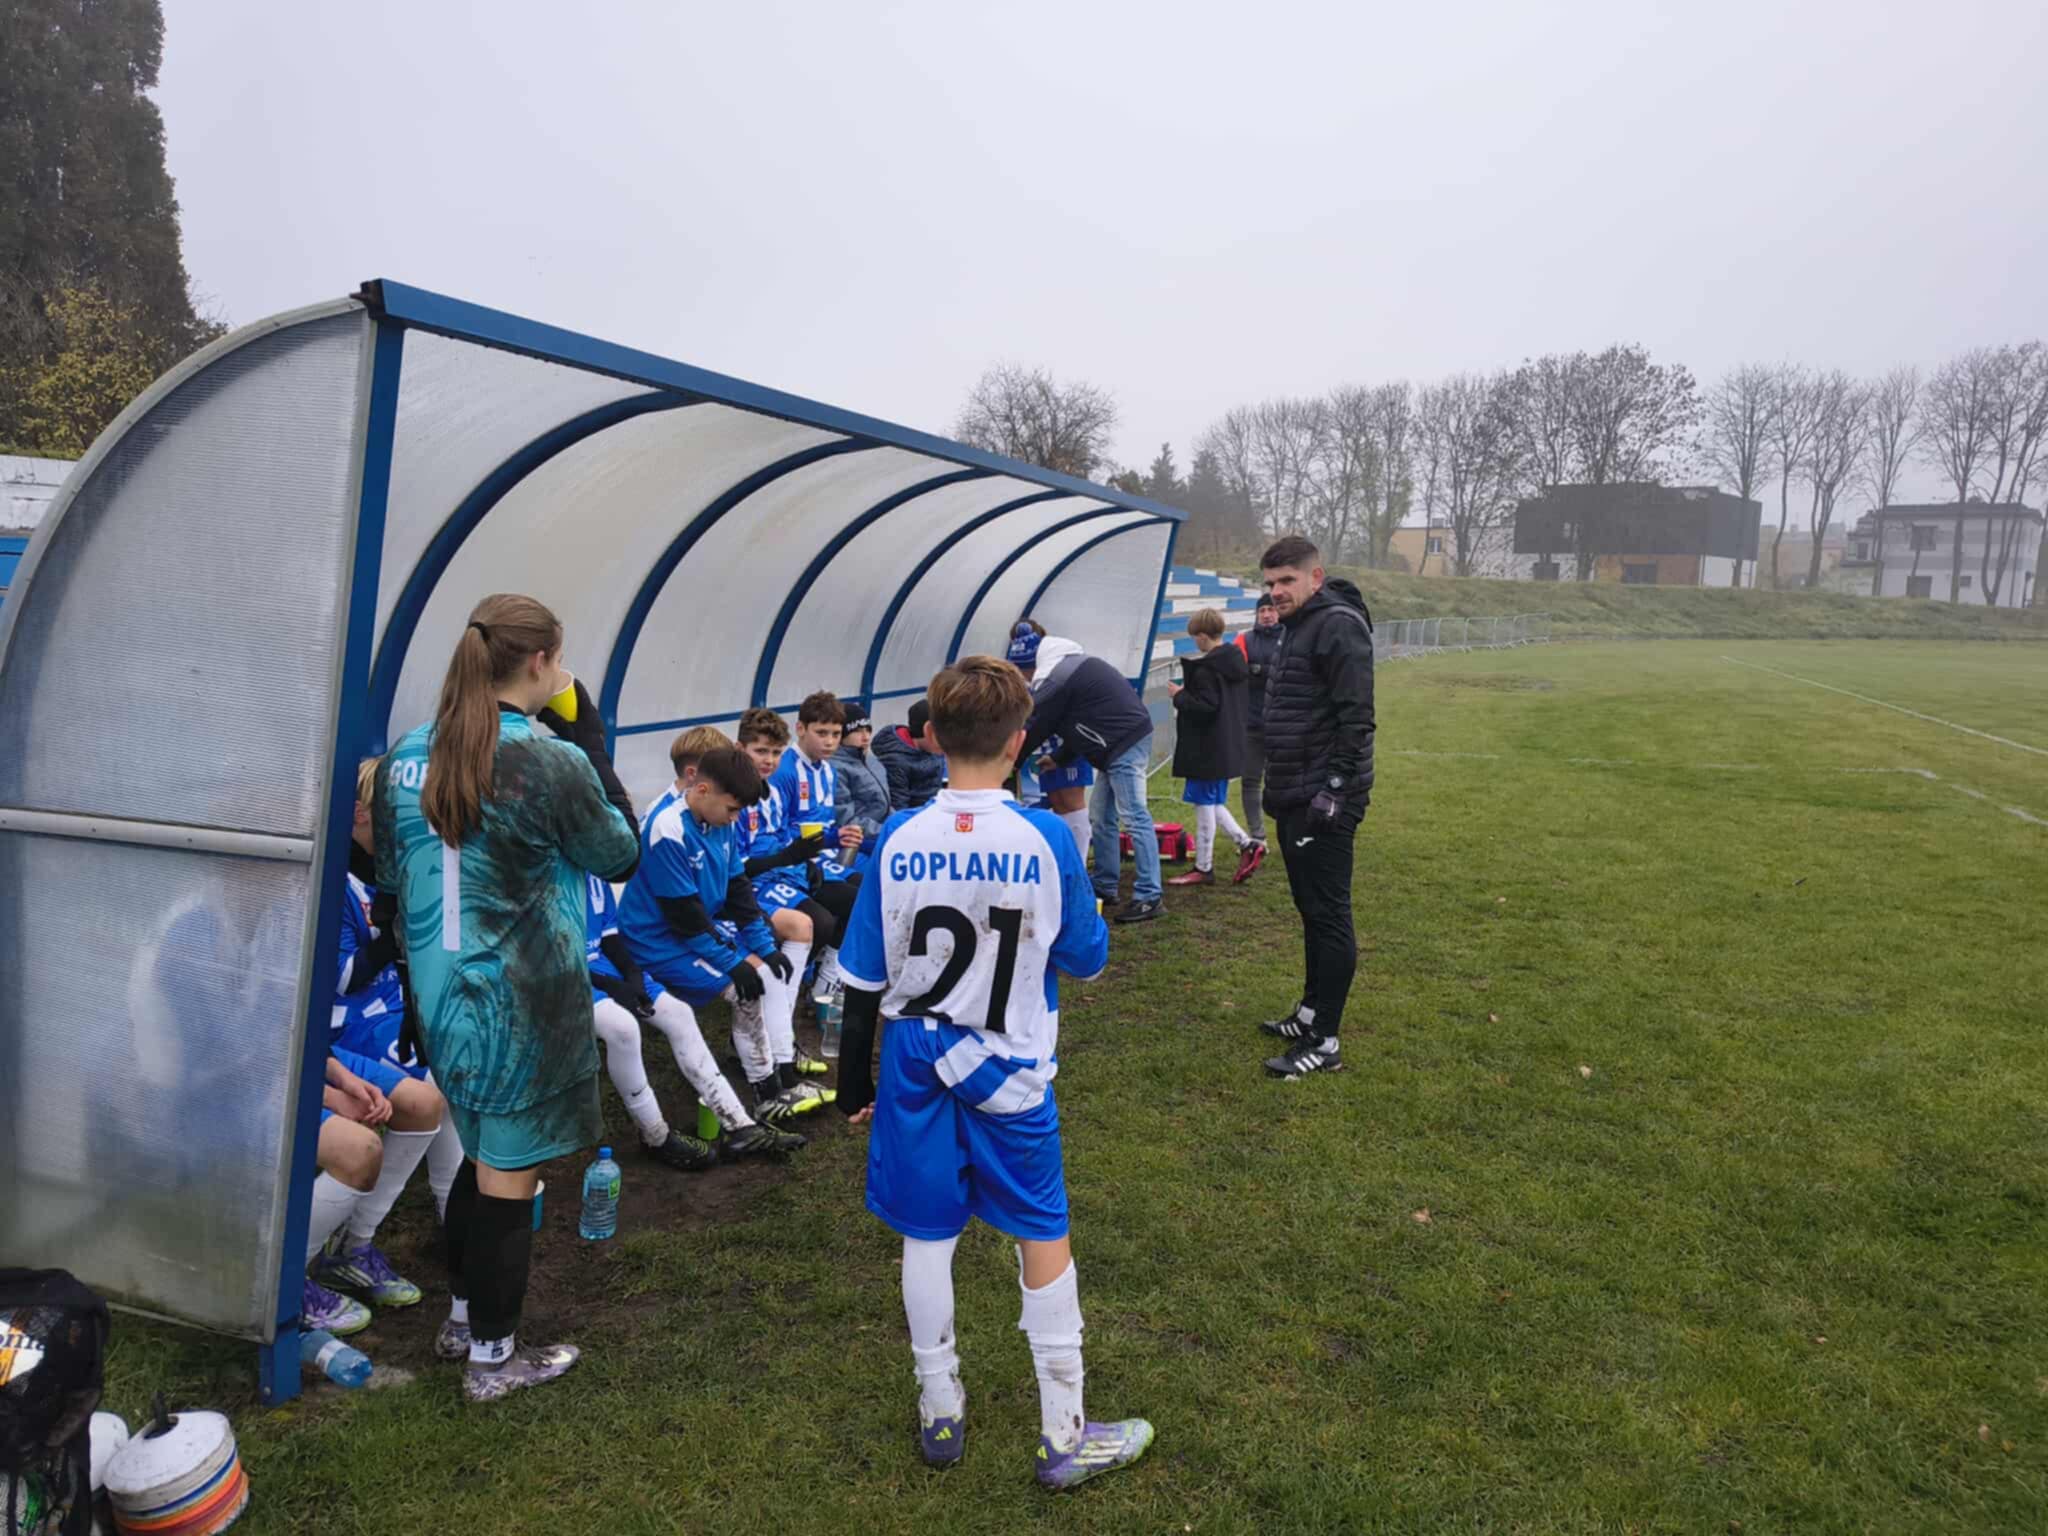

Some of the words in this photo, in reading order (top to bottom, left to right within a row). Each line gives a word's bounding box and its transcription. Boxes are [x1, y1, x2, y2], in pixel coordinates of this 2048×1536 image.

[889, 851, 1041, 884] GOPLANIA
[764, 883, 798, 906] 18
[897, 904, 1023, 1035] 21
